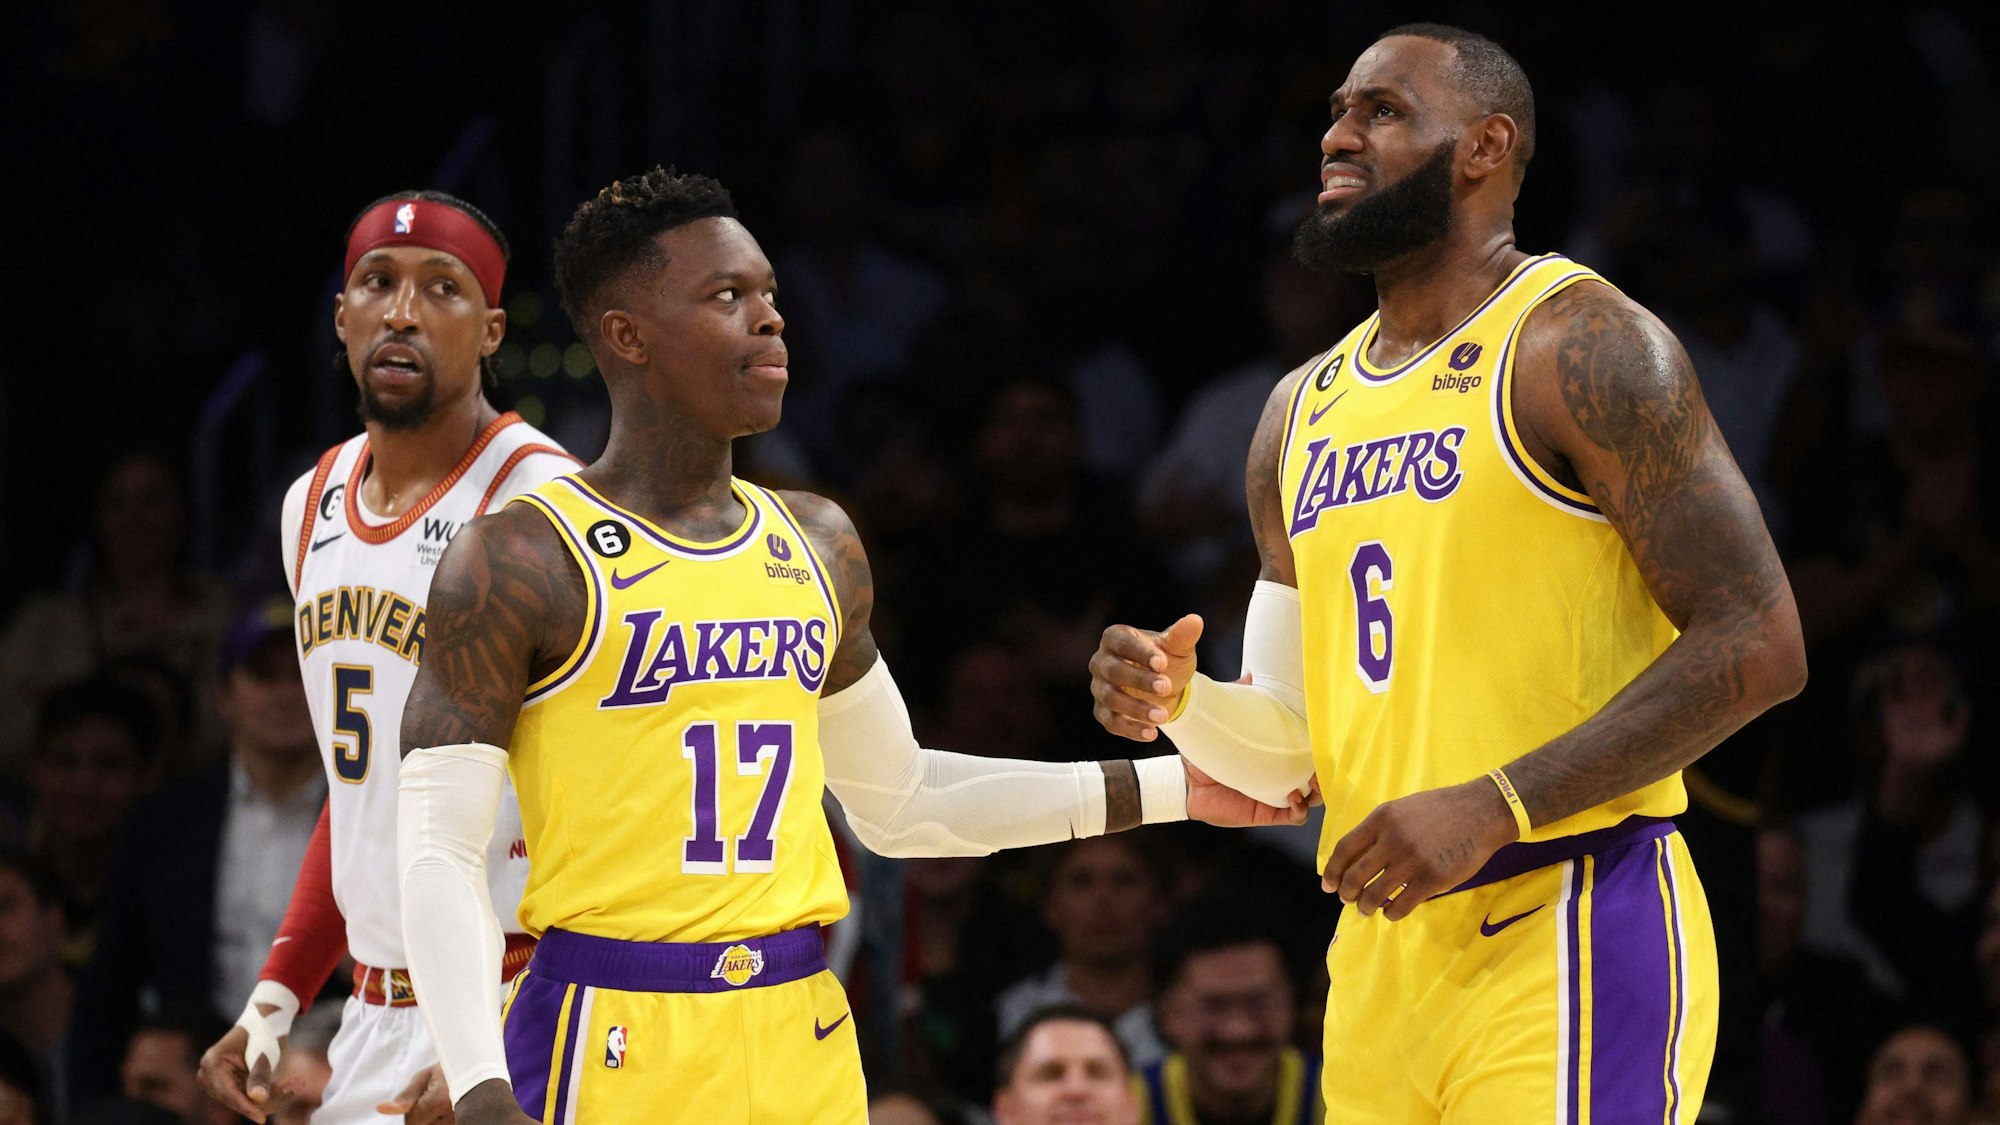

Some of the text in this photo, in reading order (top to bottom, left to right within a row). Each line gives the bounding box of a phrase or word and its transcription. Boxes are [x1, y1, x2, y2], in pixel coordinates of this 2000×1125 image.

[1321, 359, 1342, 388] 6
[1432, 373, 1482, 393] bibigo
[1289, 426, 1467, 542] LAKERS
[417, 543, 445, 555] West
[594, 524, 623, 555] 6
[764, 562, 811, 585] bibigo
[298, 586, 427, 668] DENVER
[1347, 538, 1394, 695] 6
[598, 608, 828, 710] LAKERS
[332, 663, 374, 784] 5
[681, 720, 795, 875] 17
[713, 955, 763, 977] LAKERS
